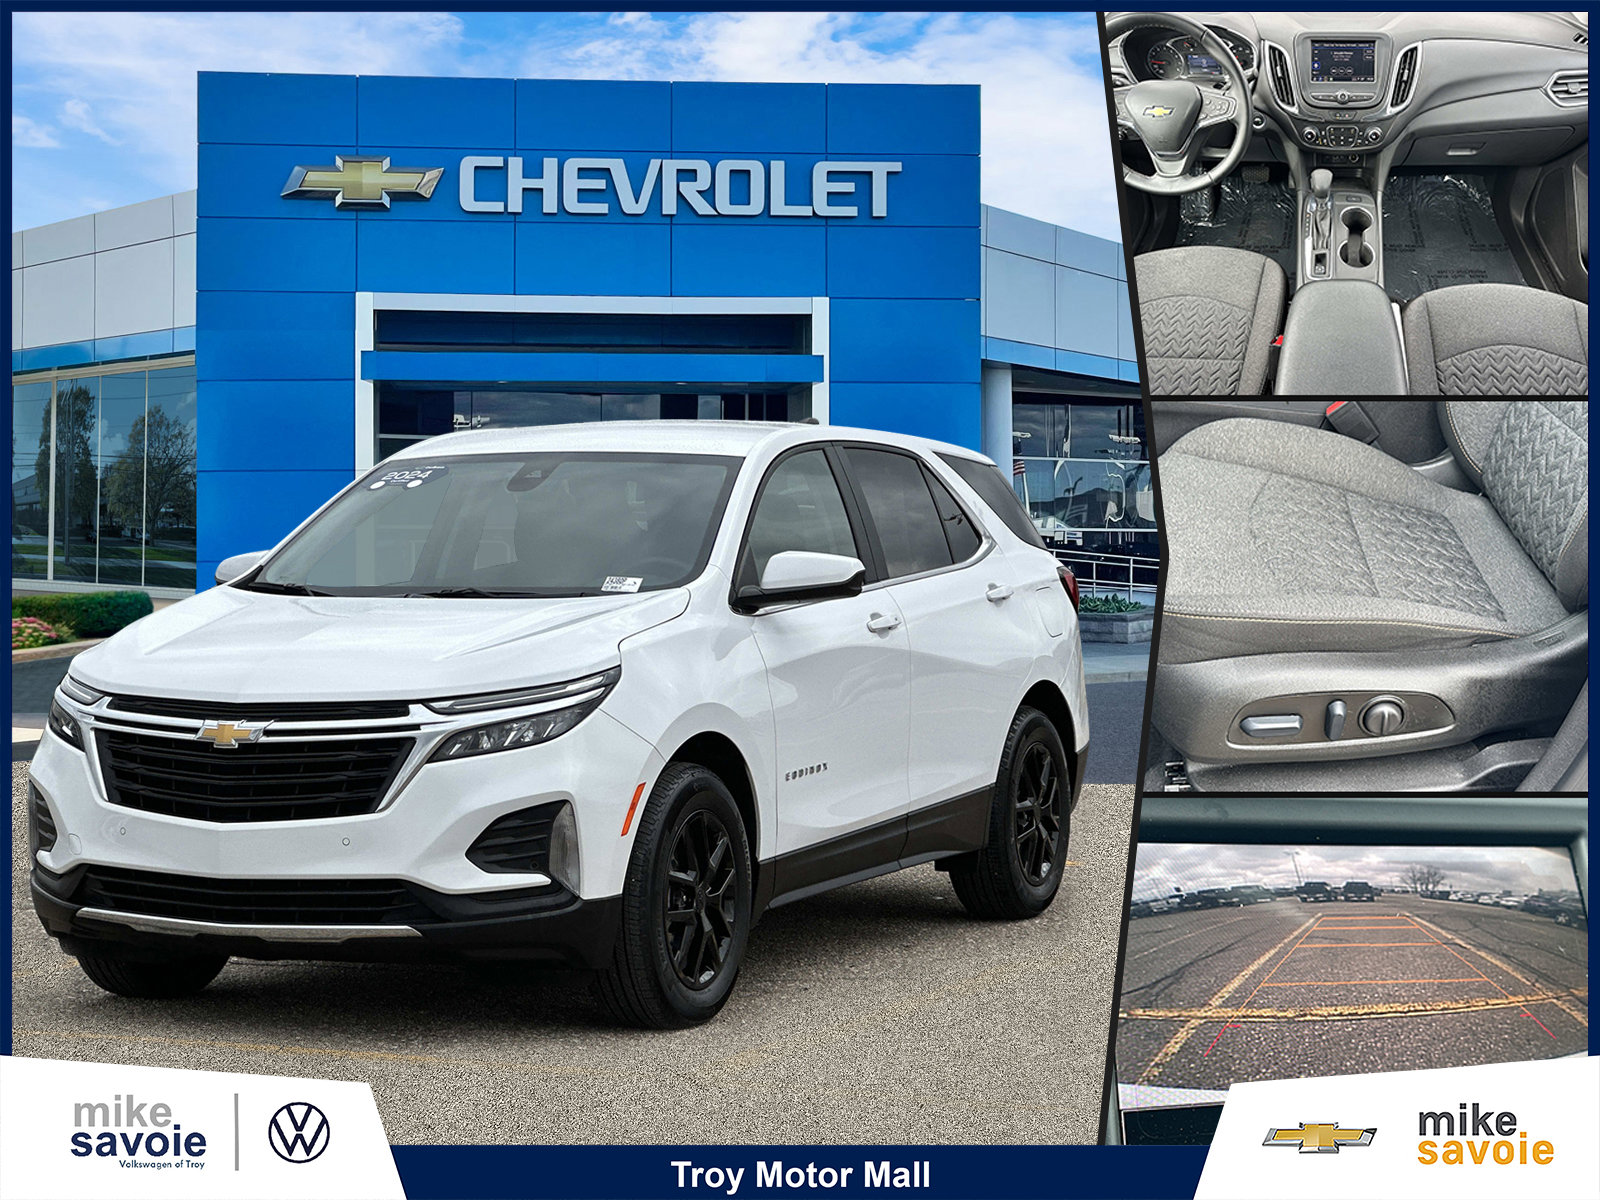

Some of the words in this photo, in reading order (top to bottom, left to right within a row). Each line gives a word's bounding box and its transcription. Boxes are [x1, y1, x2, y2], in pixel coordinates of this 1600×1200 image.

[459, 156, 902, 217] CHEVROLET
[381, 470, 433, 480] 2024
[785, 762, 828, 782] EQUINOX
